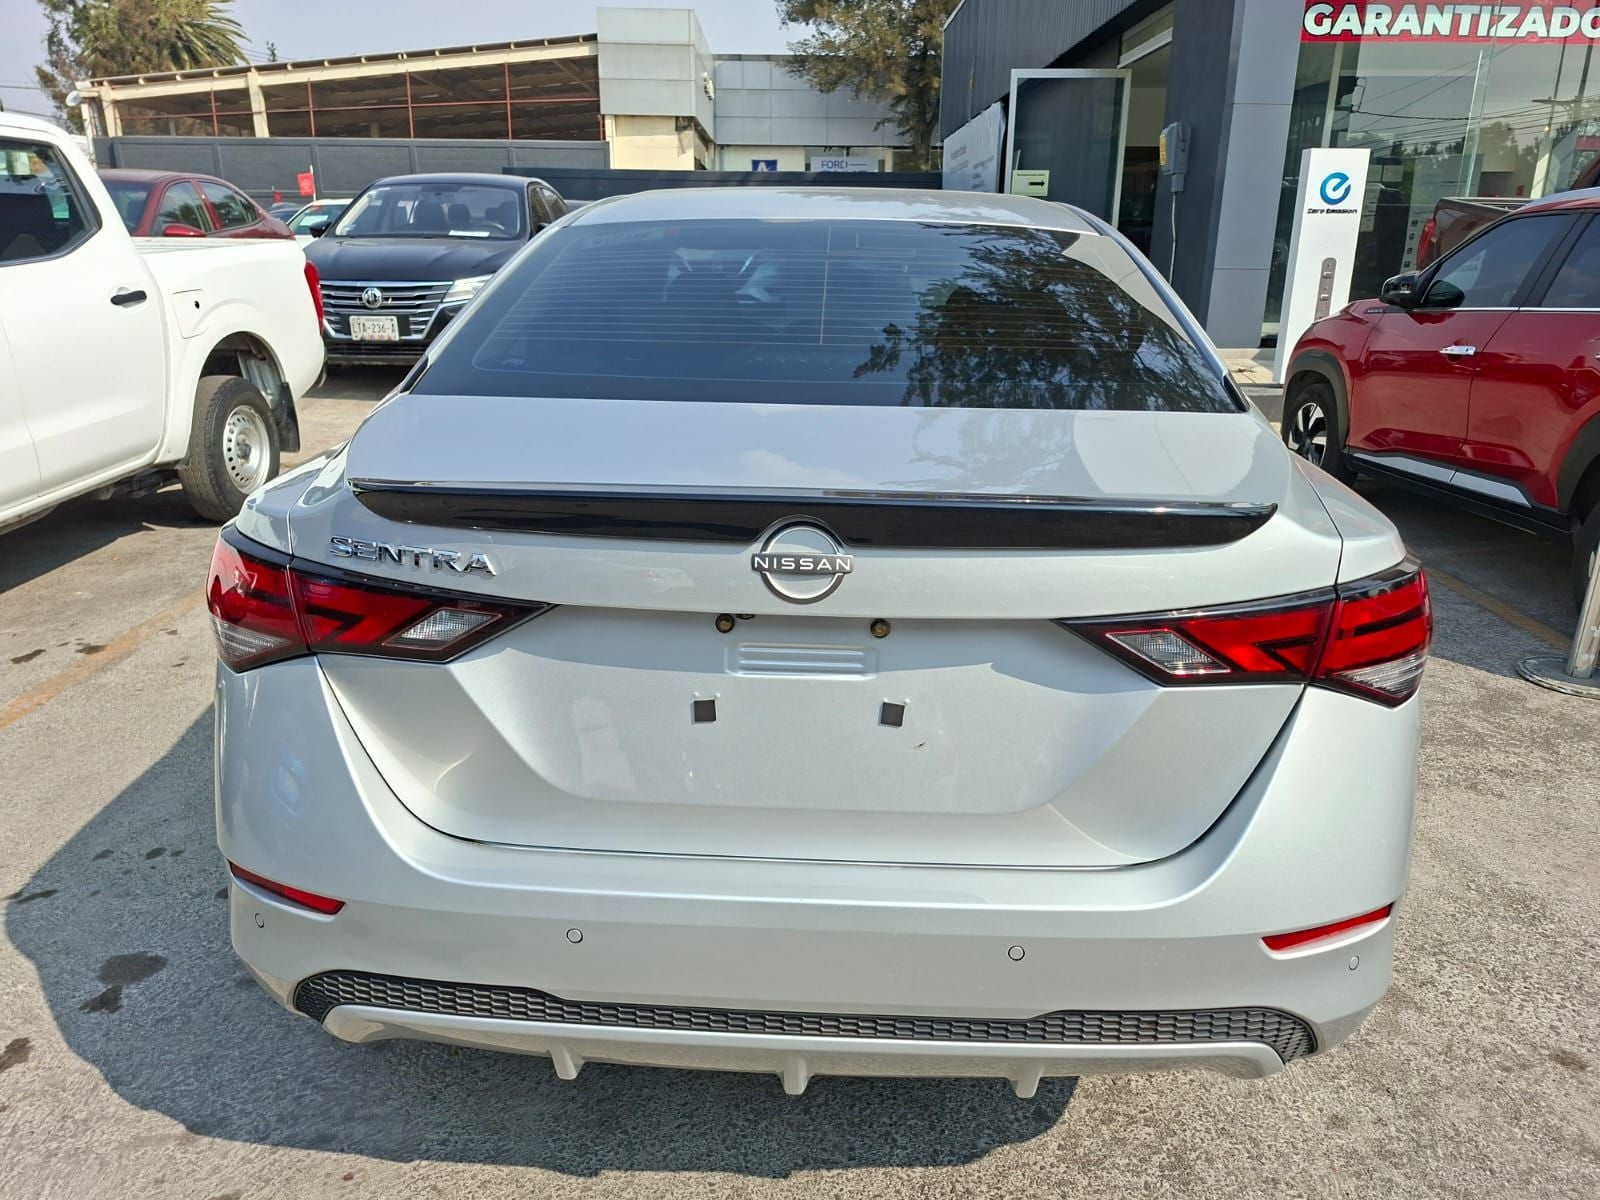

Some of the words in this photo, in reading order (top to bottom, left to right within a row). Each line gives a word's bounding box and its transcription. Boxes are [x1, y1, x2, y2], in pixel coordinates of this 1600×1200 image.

[1303, 3, 1600, 38] GARANTIZADO
[330, 535, 497, 577] SENTRA
[754, 556, 851, 571] NISSAN
